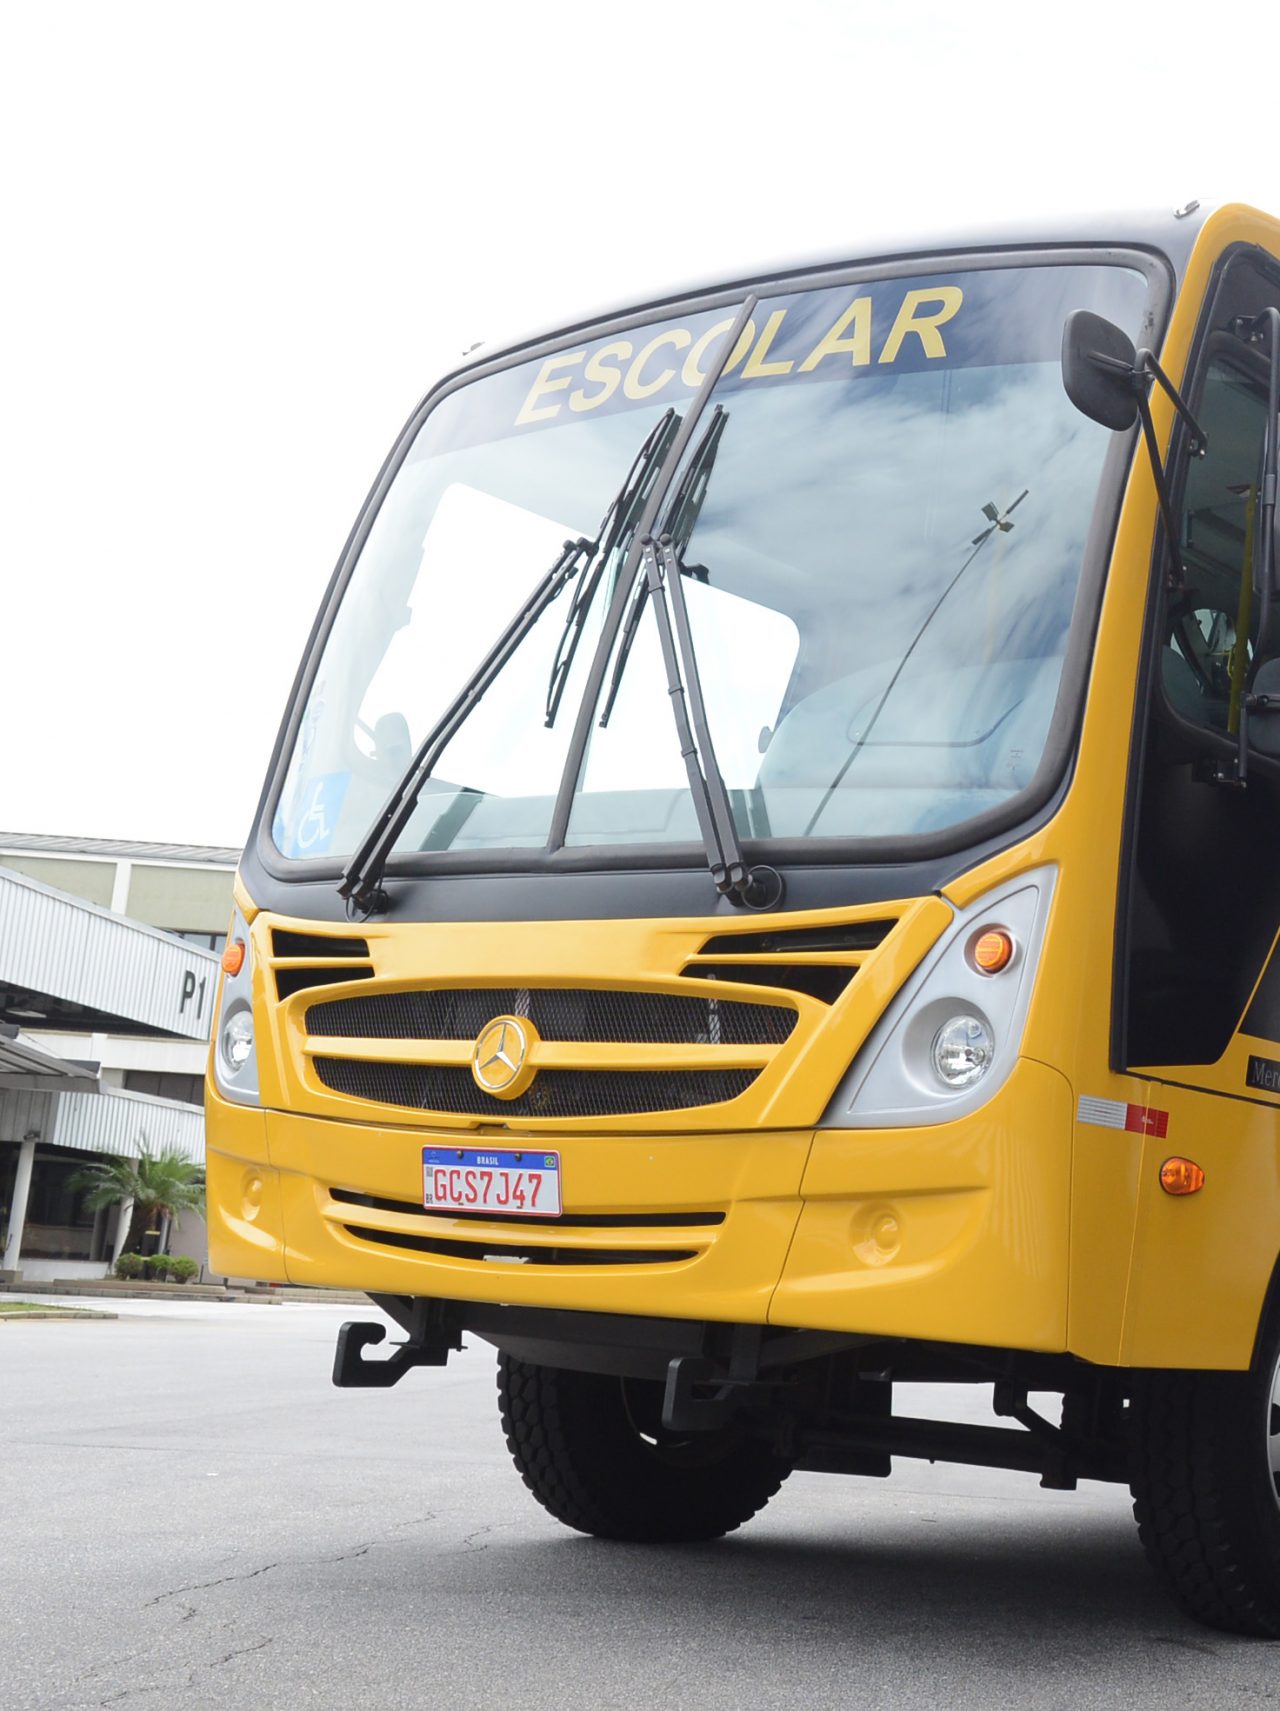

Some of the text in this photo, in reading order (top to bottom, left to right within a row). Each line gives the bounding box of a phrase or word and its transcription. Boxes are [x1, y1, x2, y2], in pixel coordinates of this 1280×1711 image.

[514, 285, 964, 427] ESCOLAR
[180, 970, 207, 1020] P1
[476, 1155, 500, 1166] BRASIL
[434, 1168, 543, 1208] GCS7J47
